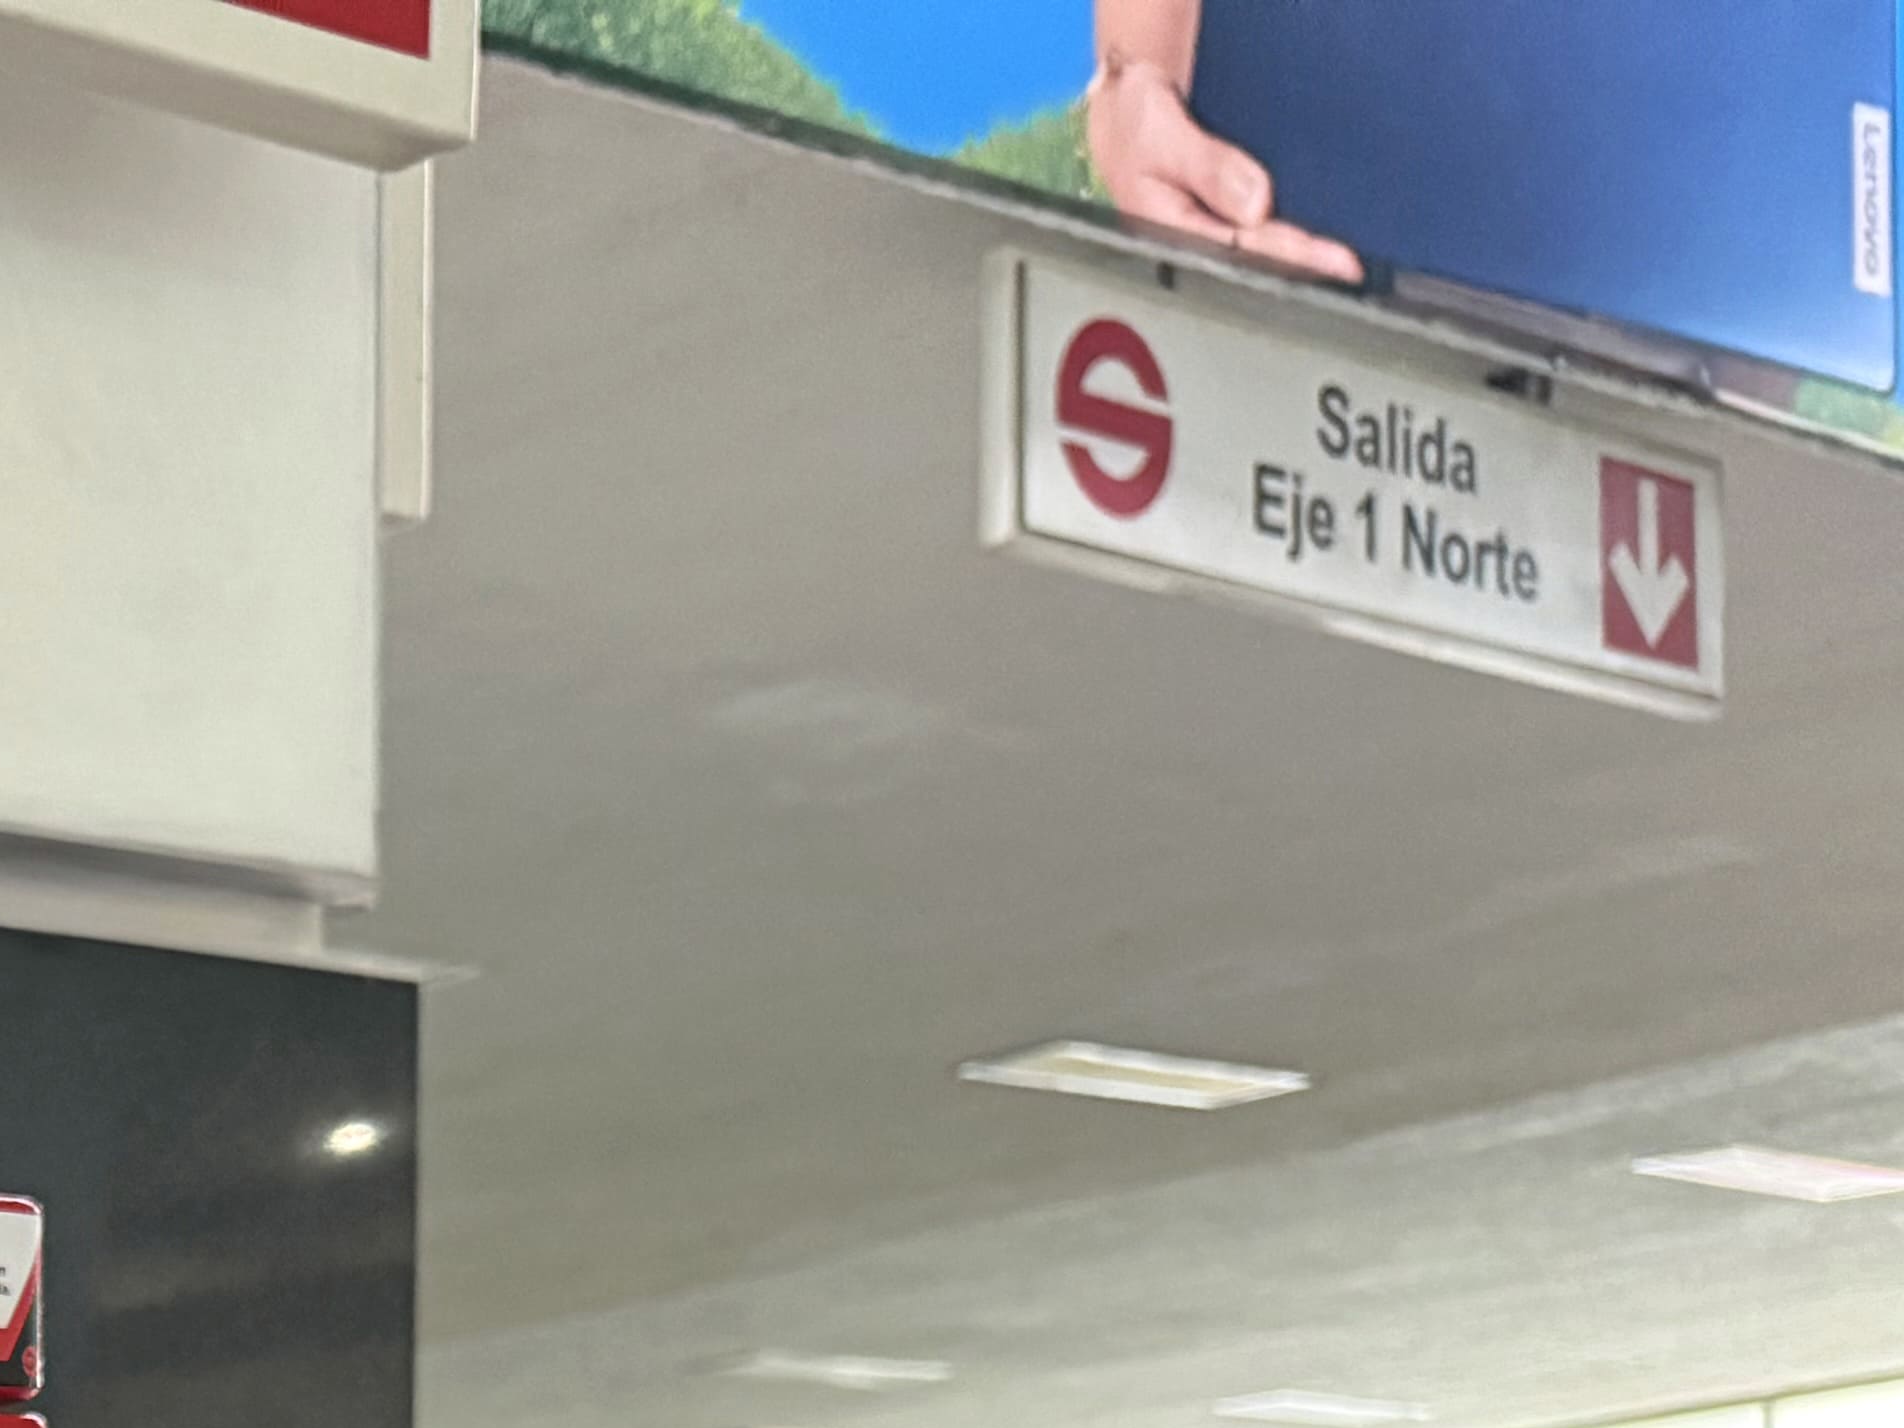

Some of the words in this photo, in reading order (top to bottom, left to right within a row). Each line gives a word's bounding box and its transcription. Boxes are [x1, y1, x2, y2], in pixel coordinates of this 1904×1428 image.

[1318, 386, 1475, 494] Salida
[1254, 462, 1334, 560] Eje
[1356, 492, 1376, 560] 1
[1403, 504, 1536, 599] Norte
